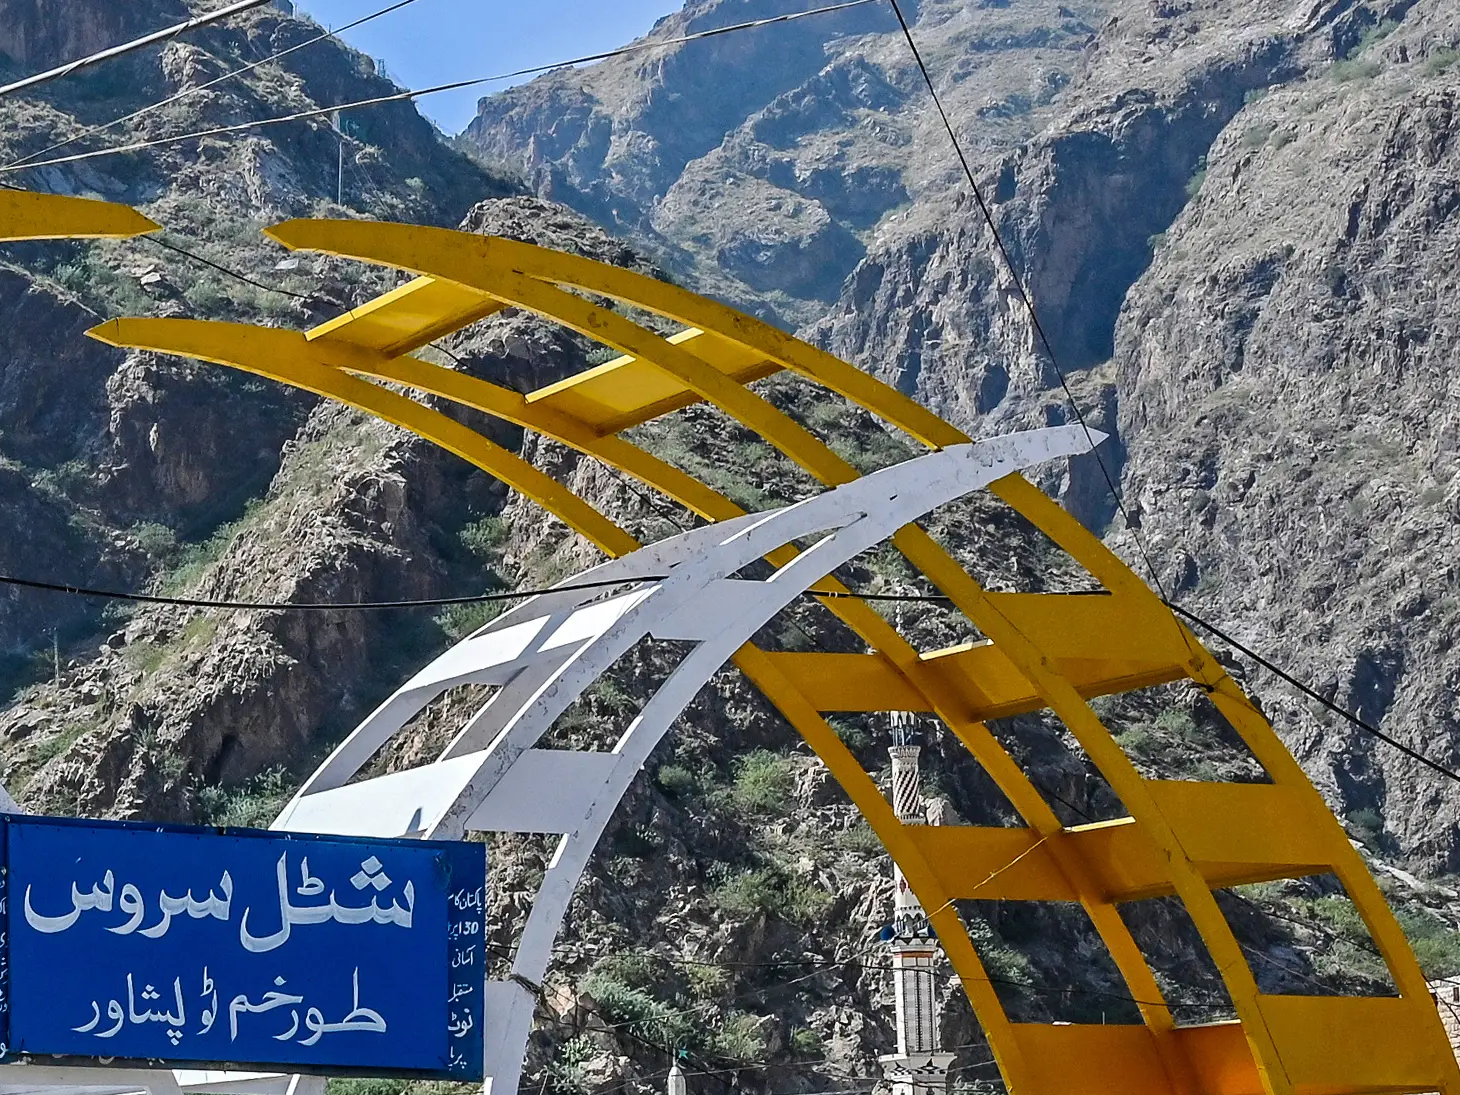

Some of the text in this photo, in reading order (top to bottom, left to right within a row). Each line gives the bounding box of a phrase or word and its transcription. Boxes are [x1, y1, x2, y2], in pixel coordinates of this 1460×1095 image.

[24, 851, 415, 953] شٹل سروس
[463, 921, 479, 935] 30
[72, 966, 387, 1046] طورخم ٹو پشاور
